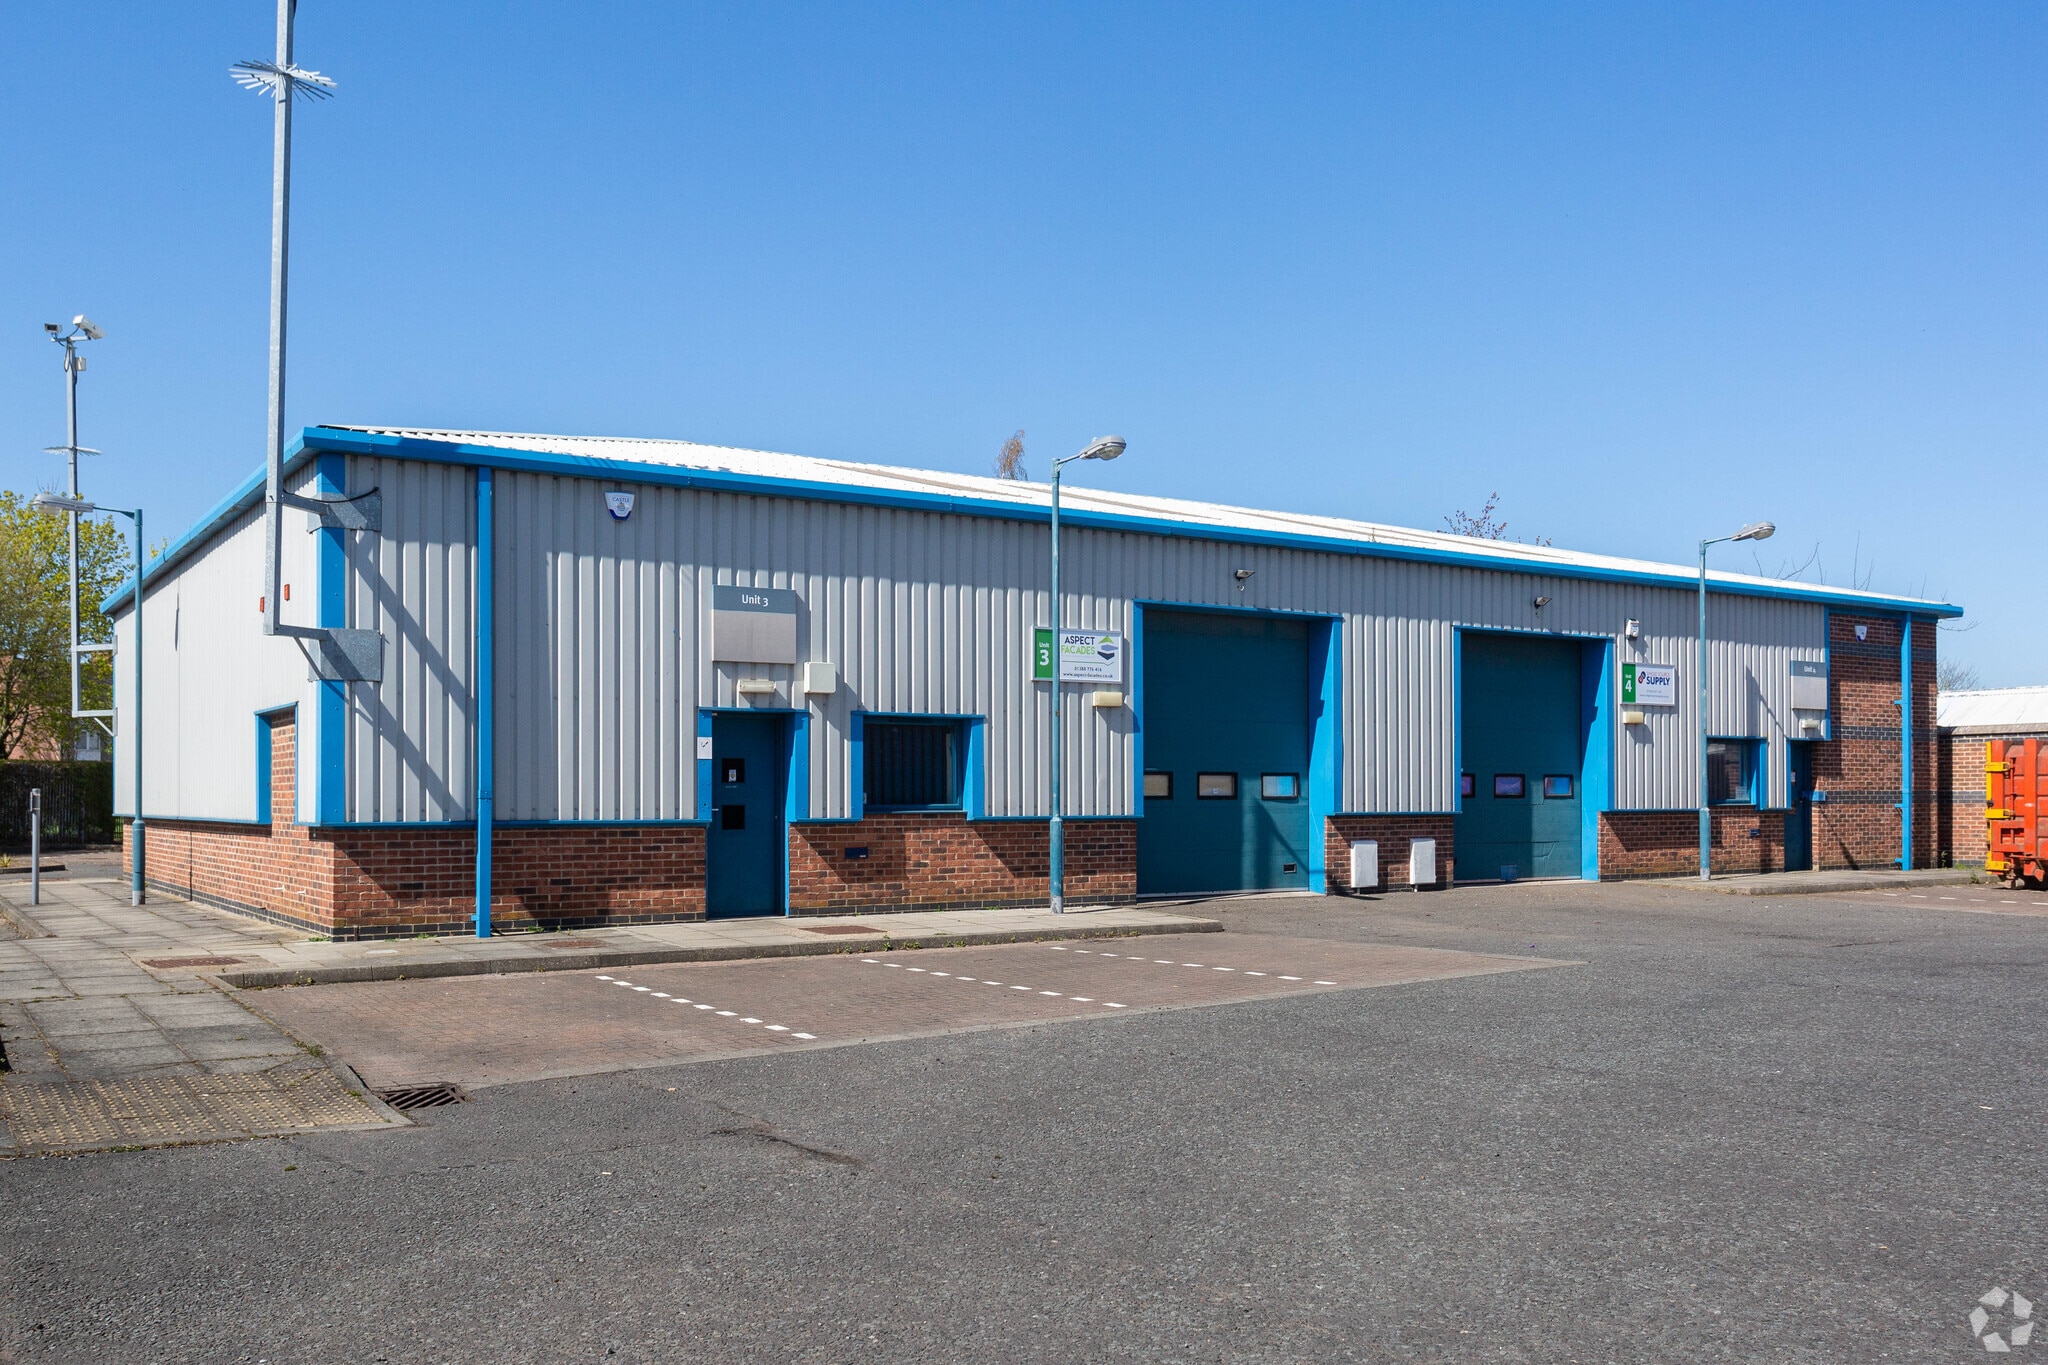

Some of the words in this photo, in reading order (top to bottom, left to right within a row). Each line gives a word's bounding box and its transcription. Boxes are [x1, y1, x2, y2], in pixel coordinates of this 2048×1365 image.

[742, 594, 761, 604] Unit
[763, 598, 768, 607] 3
[1064, 636, 1095, 645] ASPECT
[1061, 645, 1096, 654] FACADES
[1040, 649, 1050, 666] 3
[1646, 676, 1670, 685] SUPPLY
[1625, 680, 1632, 692] 4
